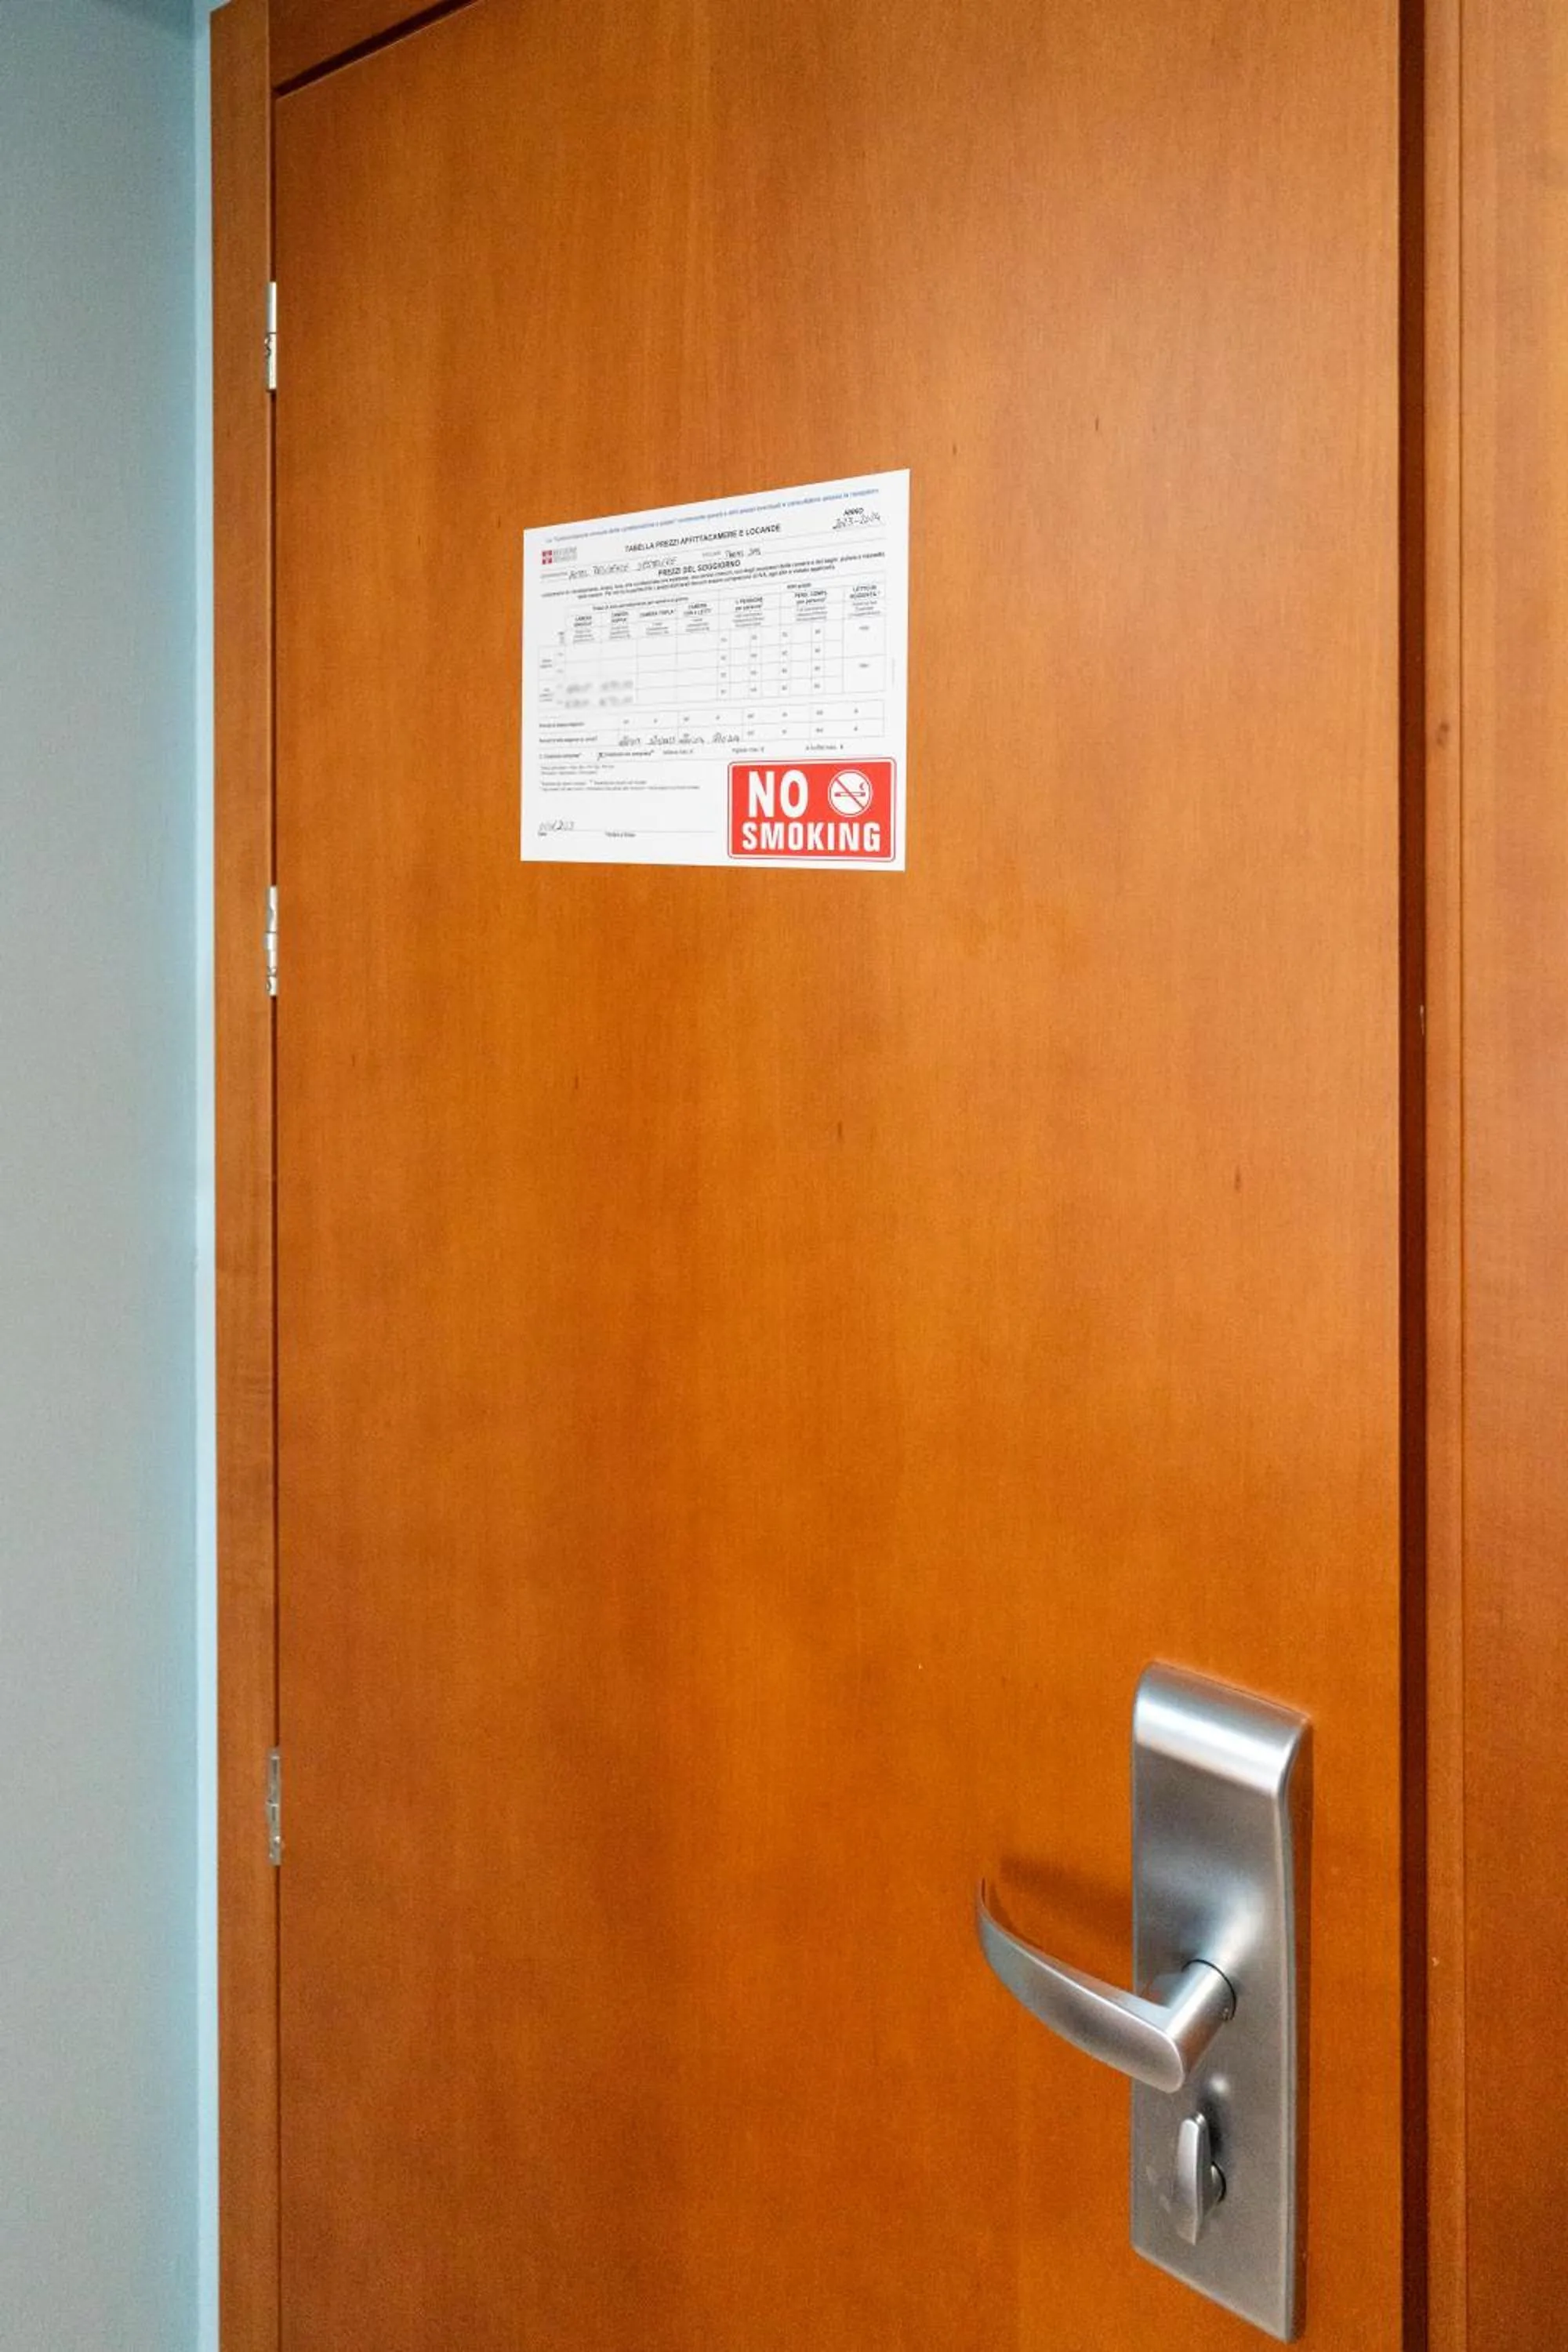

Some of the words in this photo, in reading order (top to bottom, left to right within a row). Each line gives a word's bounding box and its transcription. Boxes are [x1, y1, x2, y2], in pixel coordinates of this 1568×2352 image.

[625, 542, 655, 552] TABELLA
[655, 539, 680, 547] PREZZI
[746, 523, 781, 535] LOCANDE
[747, 769, 809, 818] NO
[742, 822, 881, 852] SMOKING
